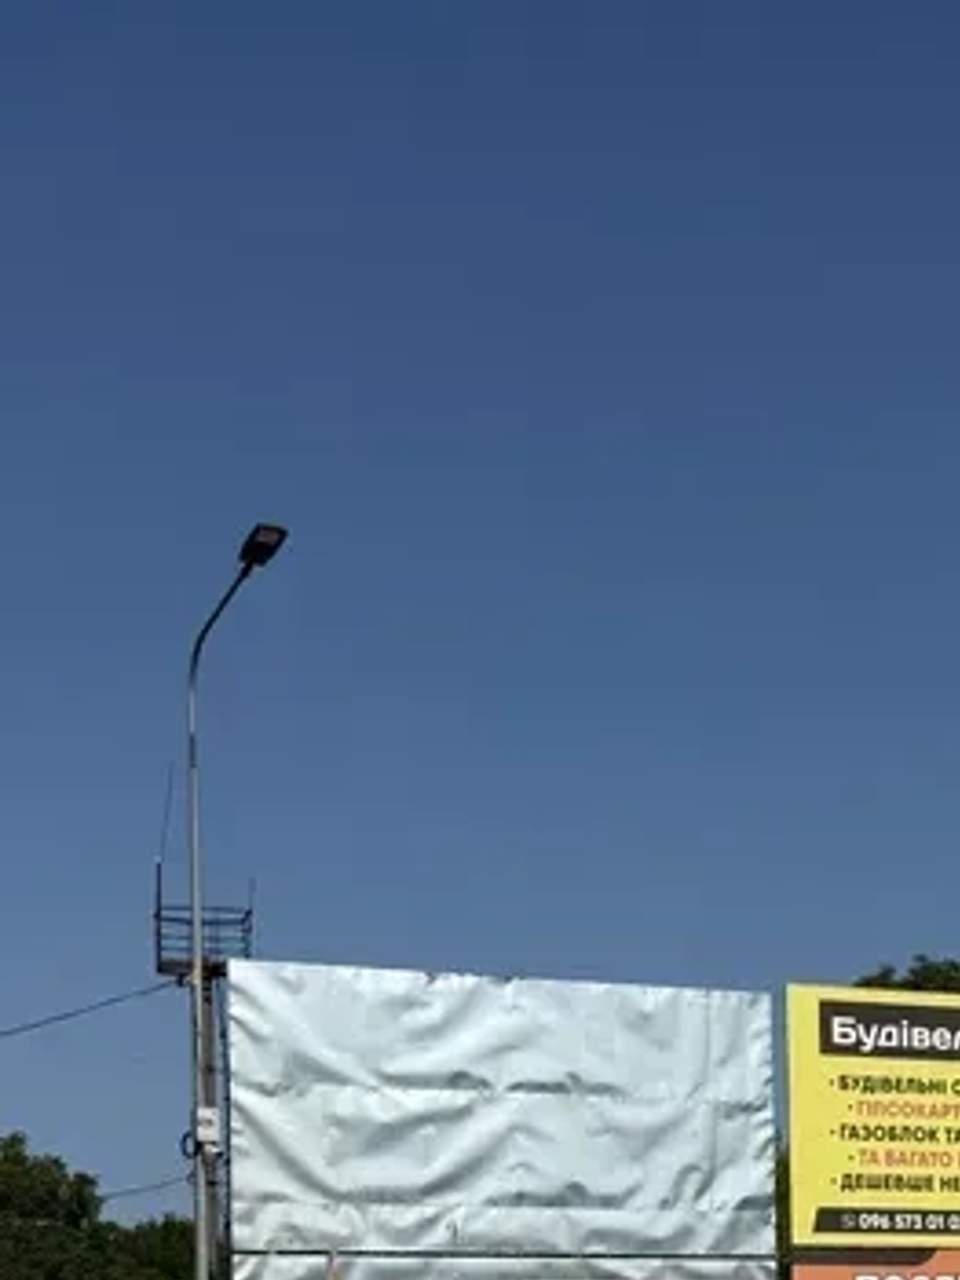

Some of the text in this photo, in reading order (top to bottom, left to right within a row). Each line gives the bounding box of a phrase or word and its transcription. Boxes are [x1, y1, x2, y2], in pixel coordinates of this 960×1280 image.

[838, 1075, 947, 1095] БУДІВЕЛЬНІ
[840, 1123, 940, 1144] ГАЗОБЛОК
[858, 1148, 880, 1166] ТА
[885, 1150, 953, 1168] БАГАТО
[840, 1173, 934, 1193] ДЕШЕВШЕ
